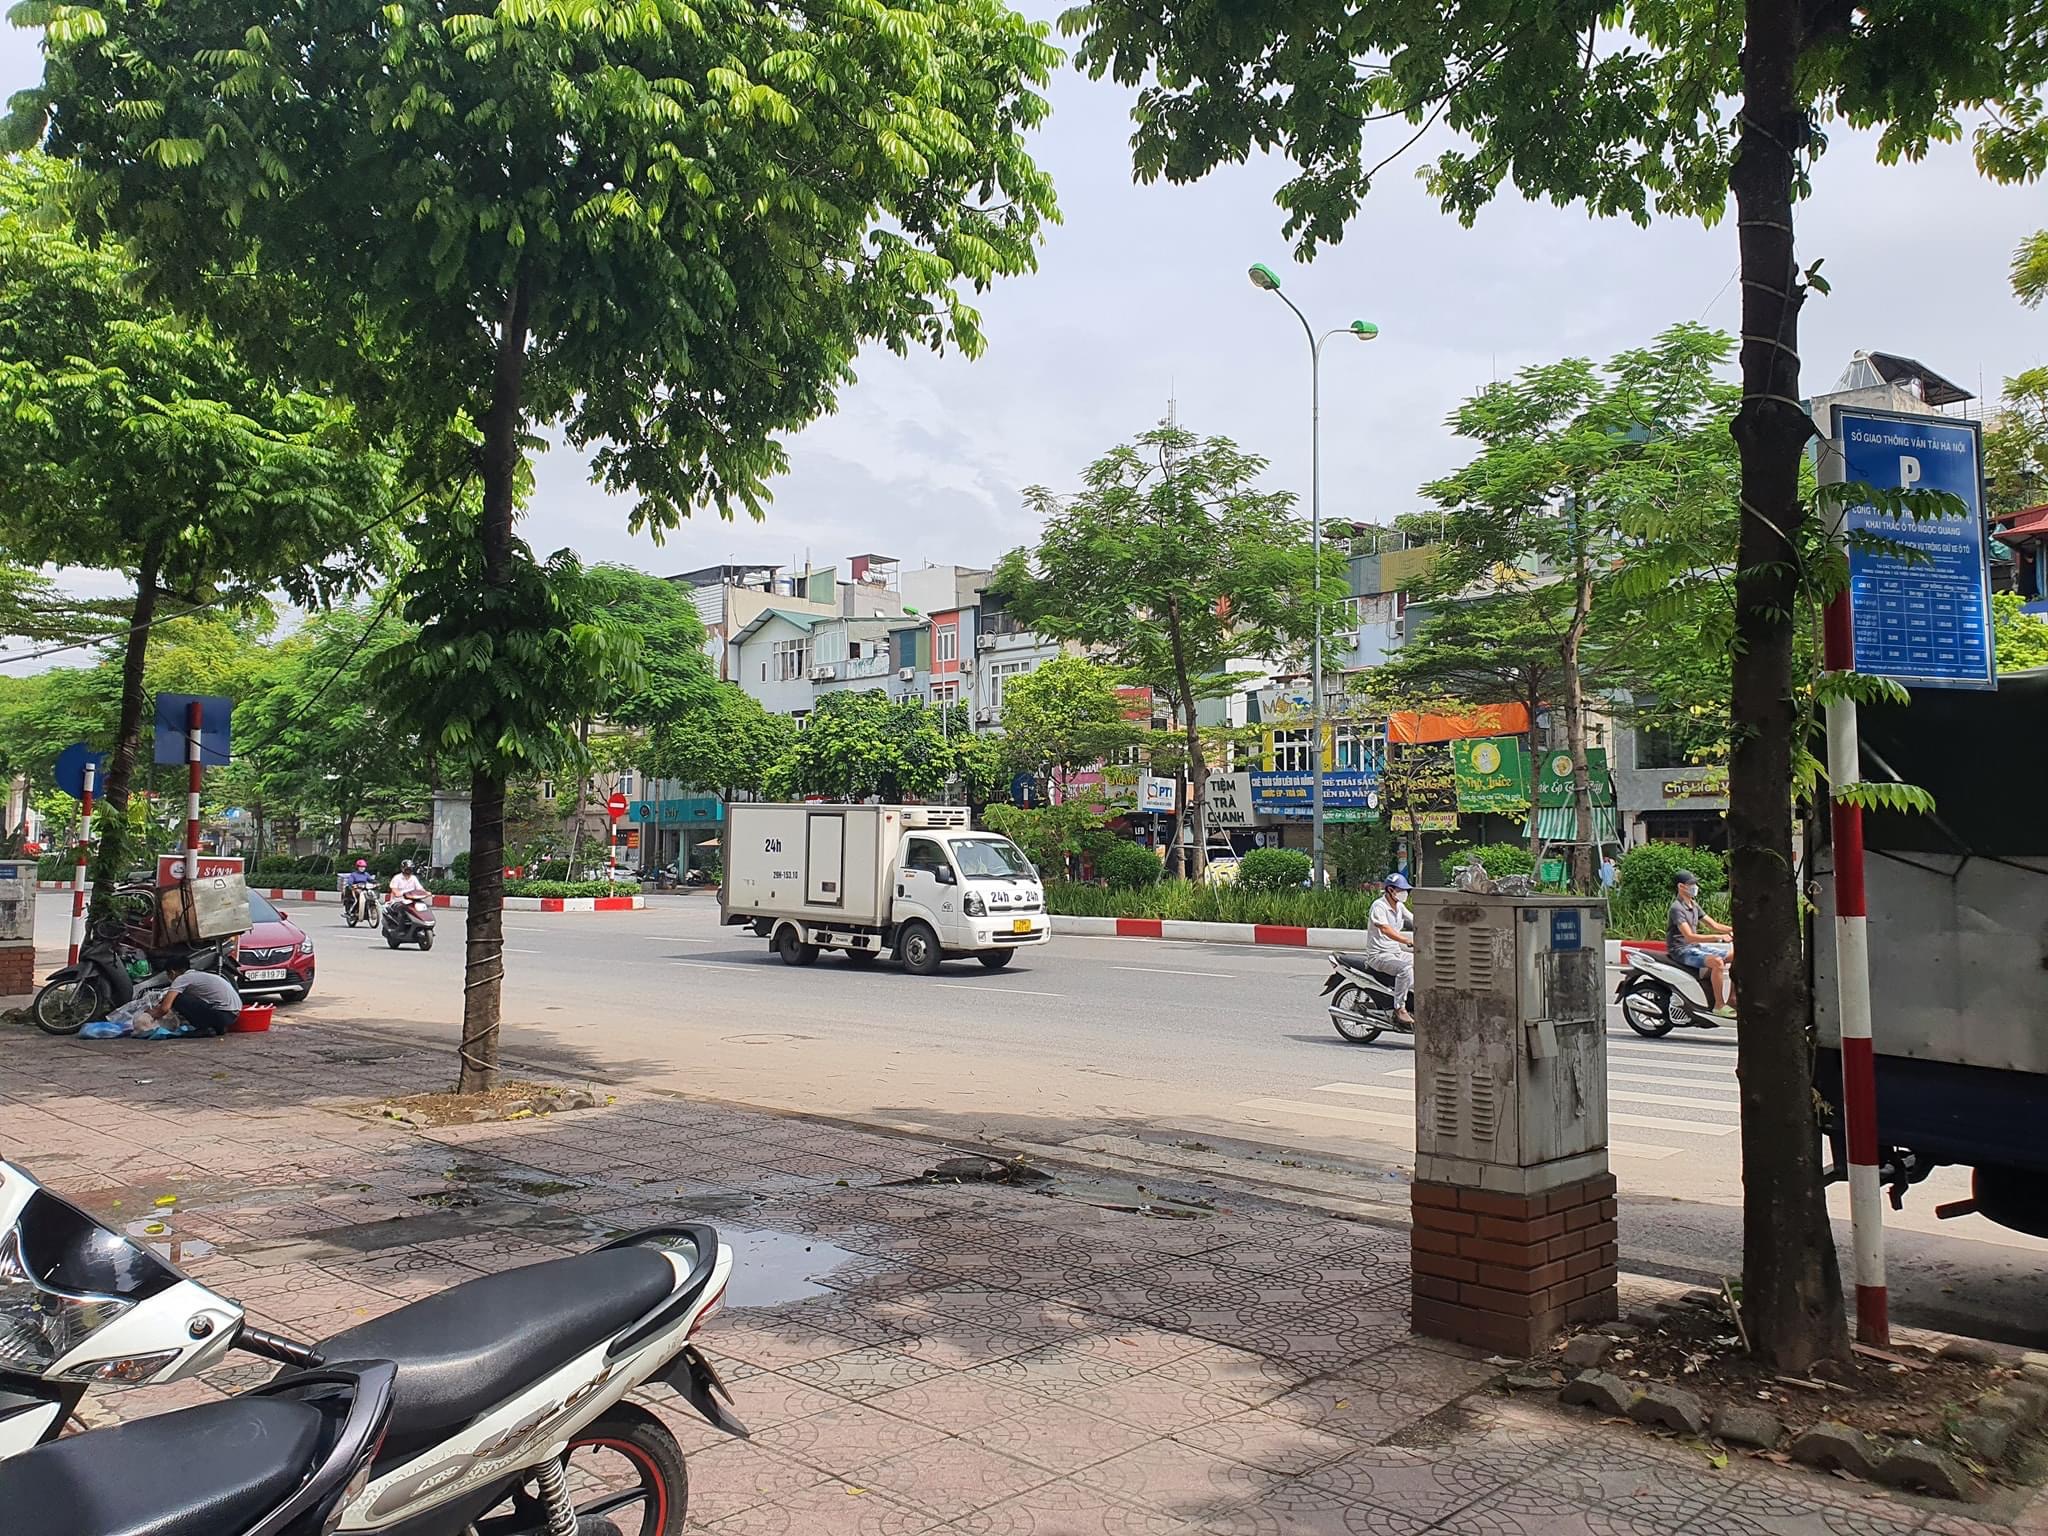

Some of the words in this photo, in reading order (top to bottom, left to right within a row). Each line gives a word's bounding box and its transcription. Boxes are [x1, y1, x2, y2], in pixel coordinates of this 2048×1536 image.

[1851, 429, 1862, 442] SỞ
[1864, 434, 1882, 444] GIAO
[1883, 434, 1909, 447] THÔNG
[1900, 456, 1921, 490] P
[1866, 521, 1881, 529] KHAI
[1882, 520, 1900, 531] THÁC
[1918, 525, 1937, 535] NGỌC
[1938, 527, 1960, 536] QUANG
[1210, 779, 1236, 794] TIỆM
[1336, 777, 1356, 786] THÁI
[1159, 786, 1172, 798] PTI
[1338, 789, 1351, 797] ĐÀ
[1213, 794, 1236, 808] TRÀ
[1208, 812, 1245, 823] CHANH
[765, 838, 782, 853] 24h
[991, 891, 1009, 903] 24h
[1026, 891, 1039, 902] 24h
